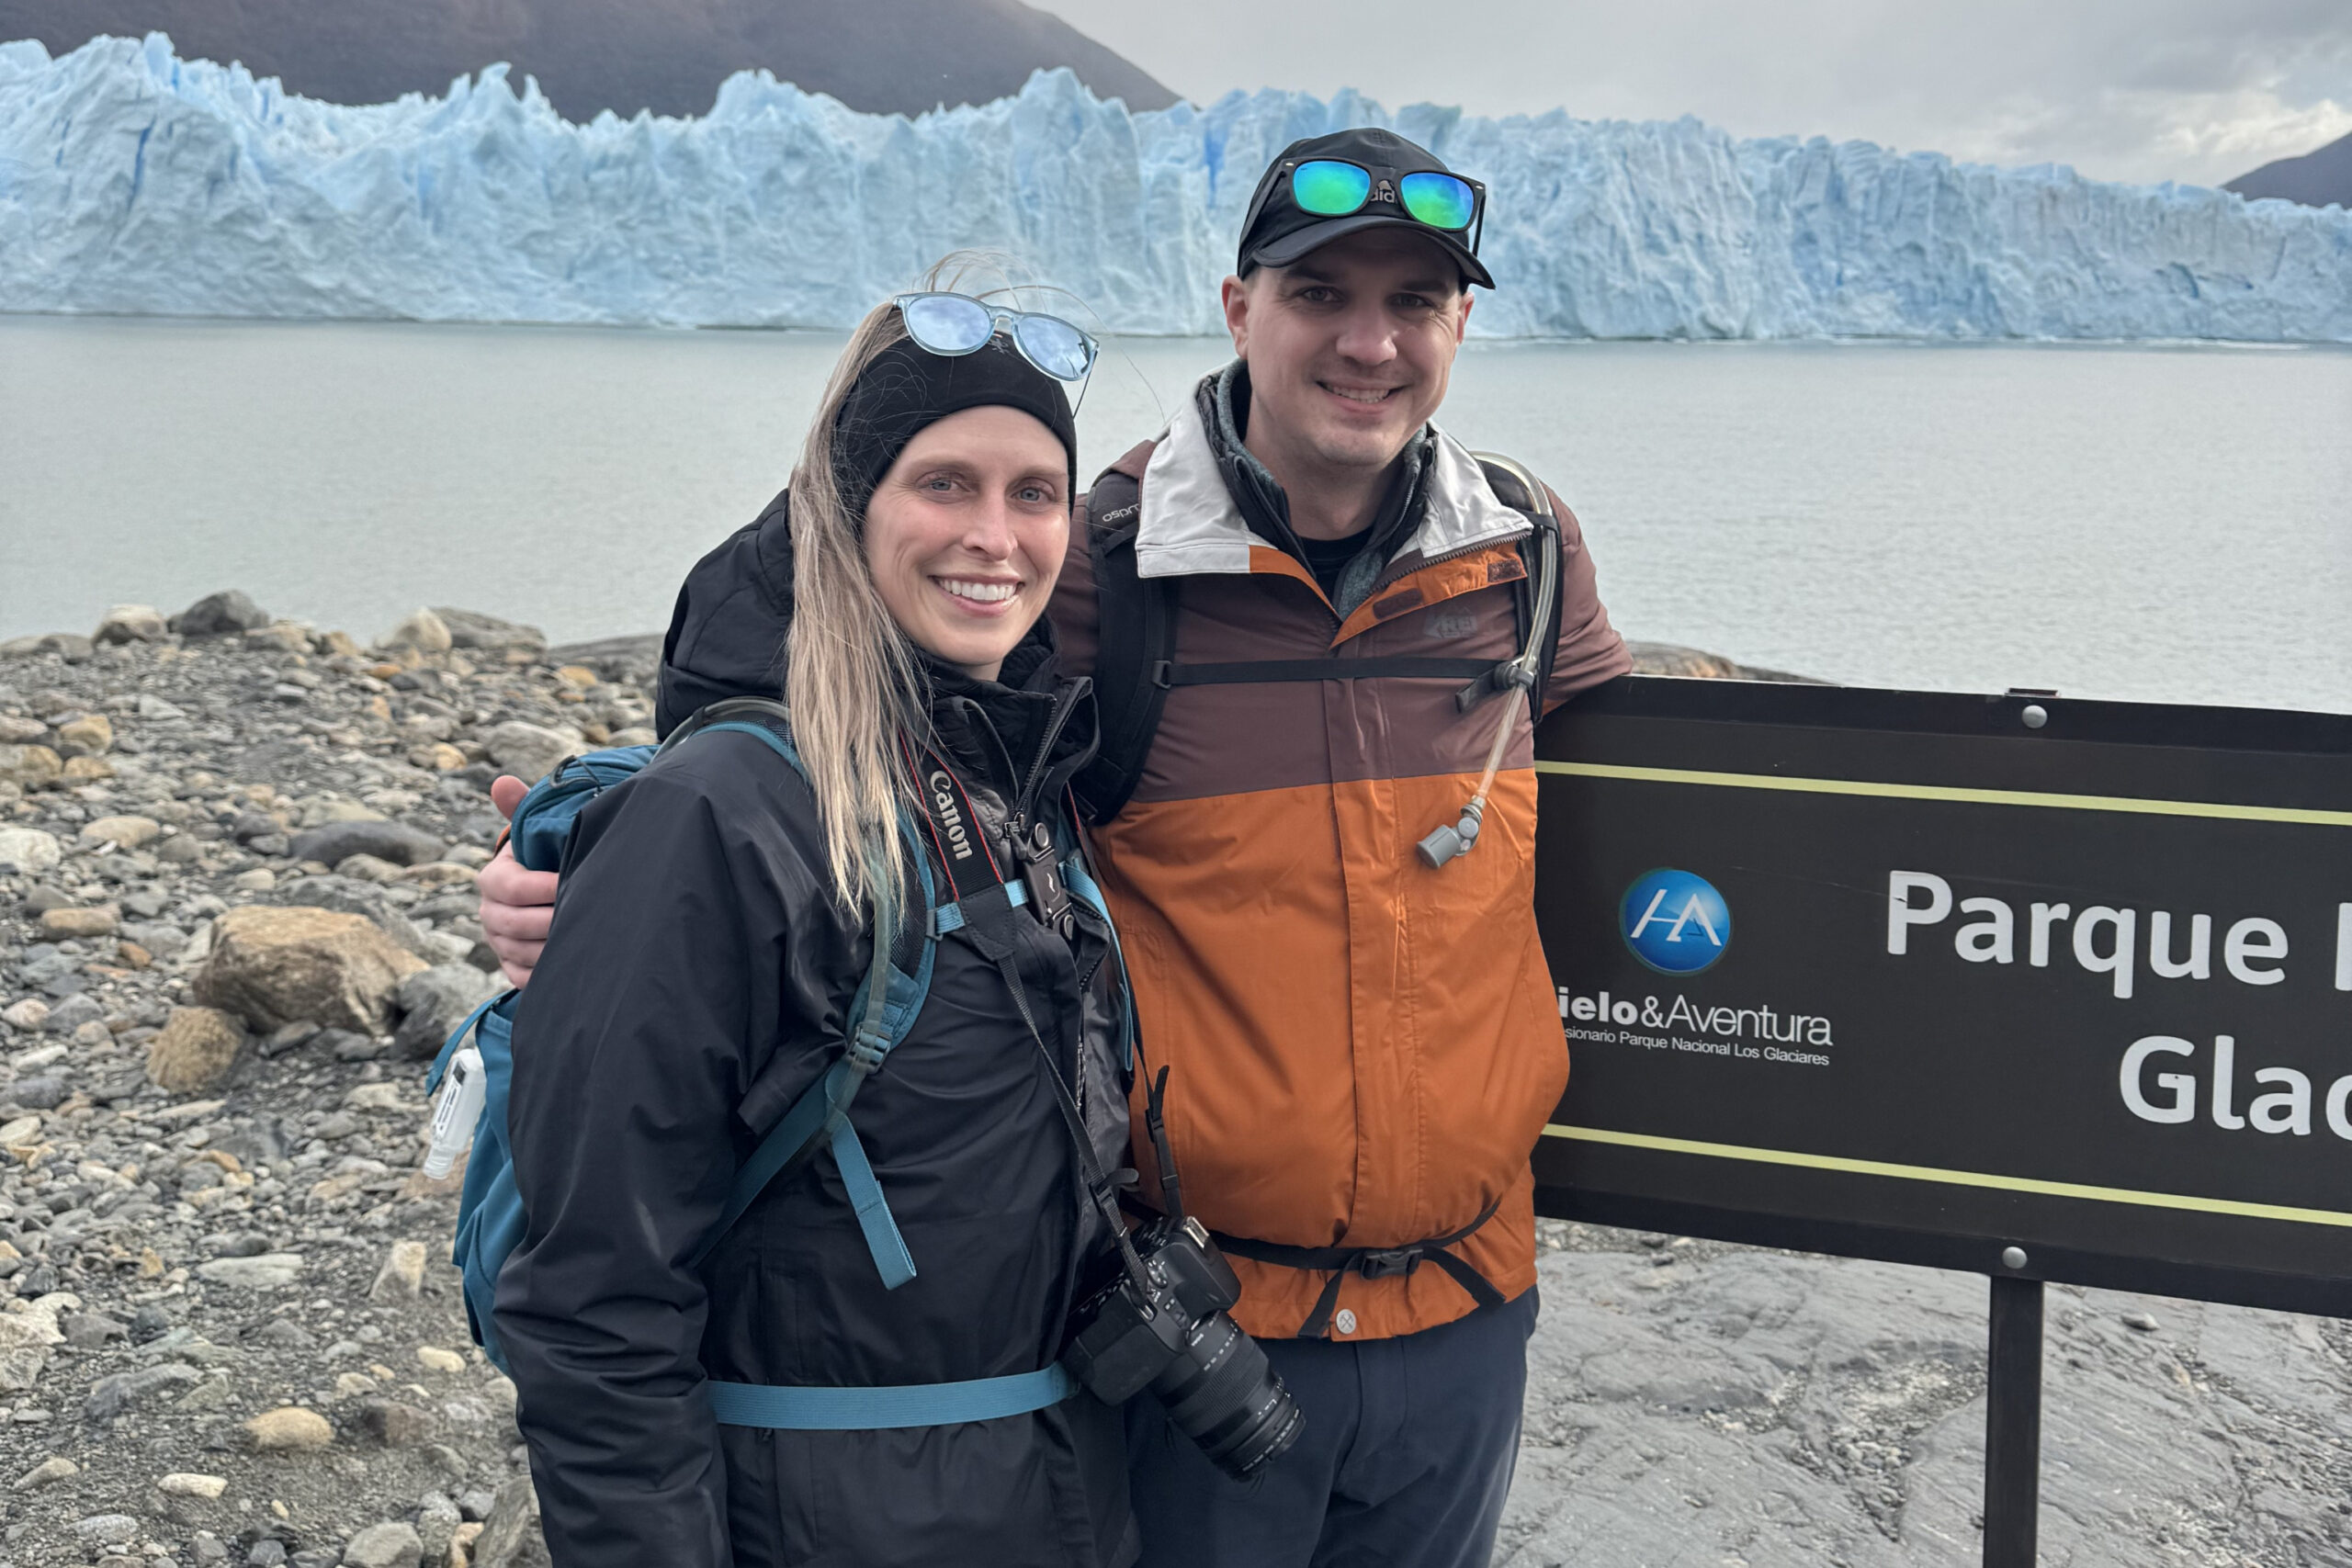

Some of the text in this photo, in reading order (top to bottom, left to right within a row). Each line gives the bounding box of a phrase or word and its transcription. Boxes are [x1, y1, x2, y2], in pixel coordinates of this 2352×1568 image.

[930, 771, 973, 860] Canon
[1886, 870, 2289, 998] Parque
[1558, 986, 1834, 1046] ielo&Aventura
[1565, 1025, 1830, 1066] sionario Parque Nacional Los Glaciares
